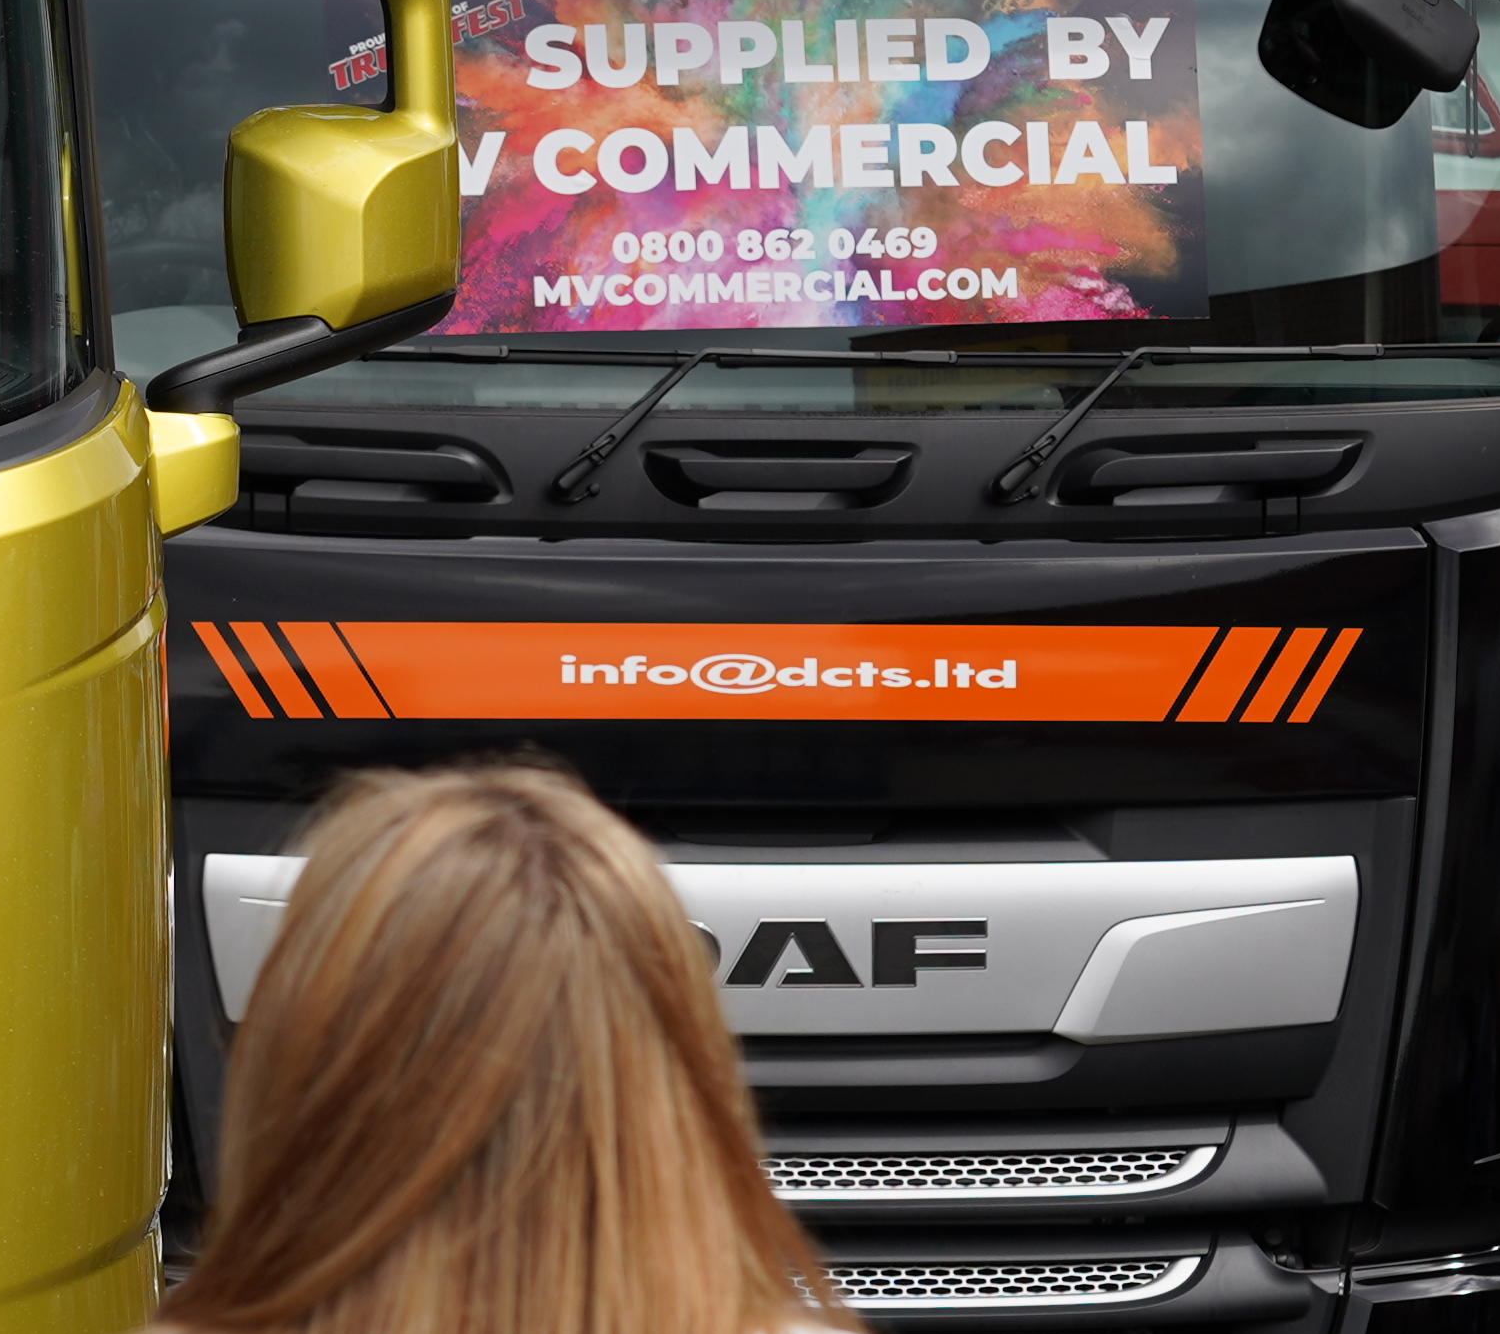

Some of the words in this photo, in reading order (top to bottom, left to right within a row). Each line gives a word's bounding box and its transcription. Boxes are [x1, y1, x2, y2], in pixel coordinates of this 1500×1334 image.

[452, 1, 469, 14] OF
[525, 18, 992, 91] SUPPLIED
[1047, 16, 1172, 81] BY
[532, 120, 1179, 197] COMMERCIAL
[612, 230, 725, 265] 0800
[736, 228, 815, 262] 862
[827, 225, 938, 261] 0469
[533, 268, 1019, 308] MVCOMMERCIAL.COM
[560, 653, 1017, 695] info@dcts.ltd
[688, 917, 989, 989] AF
